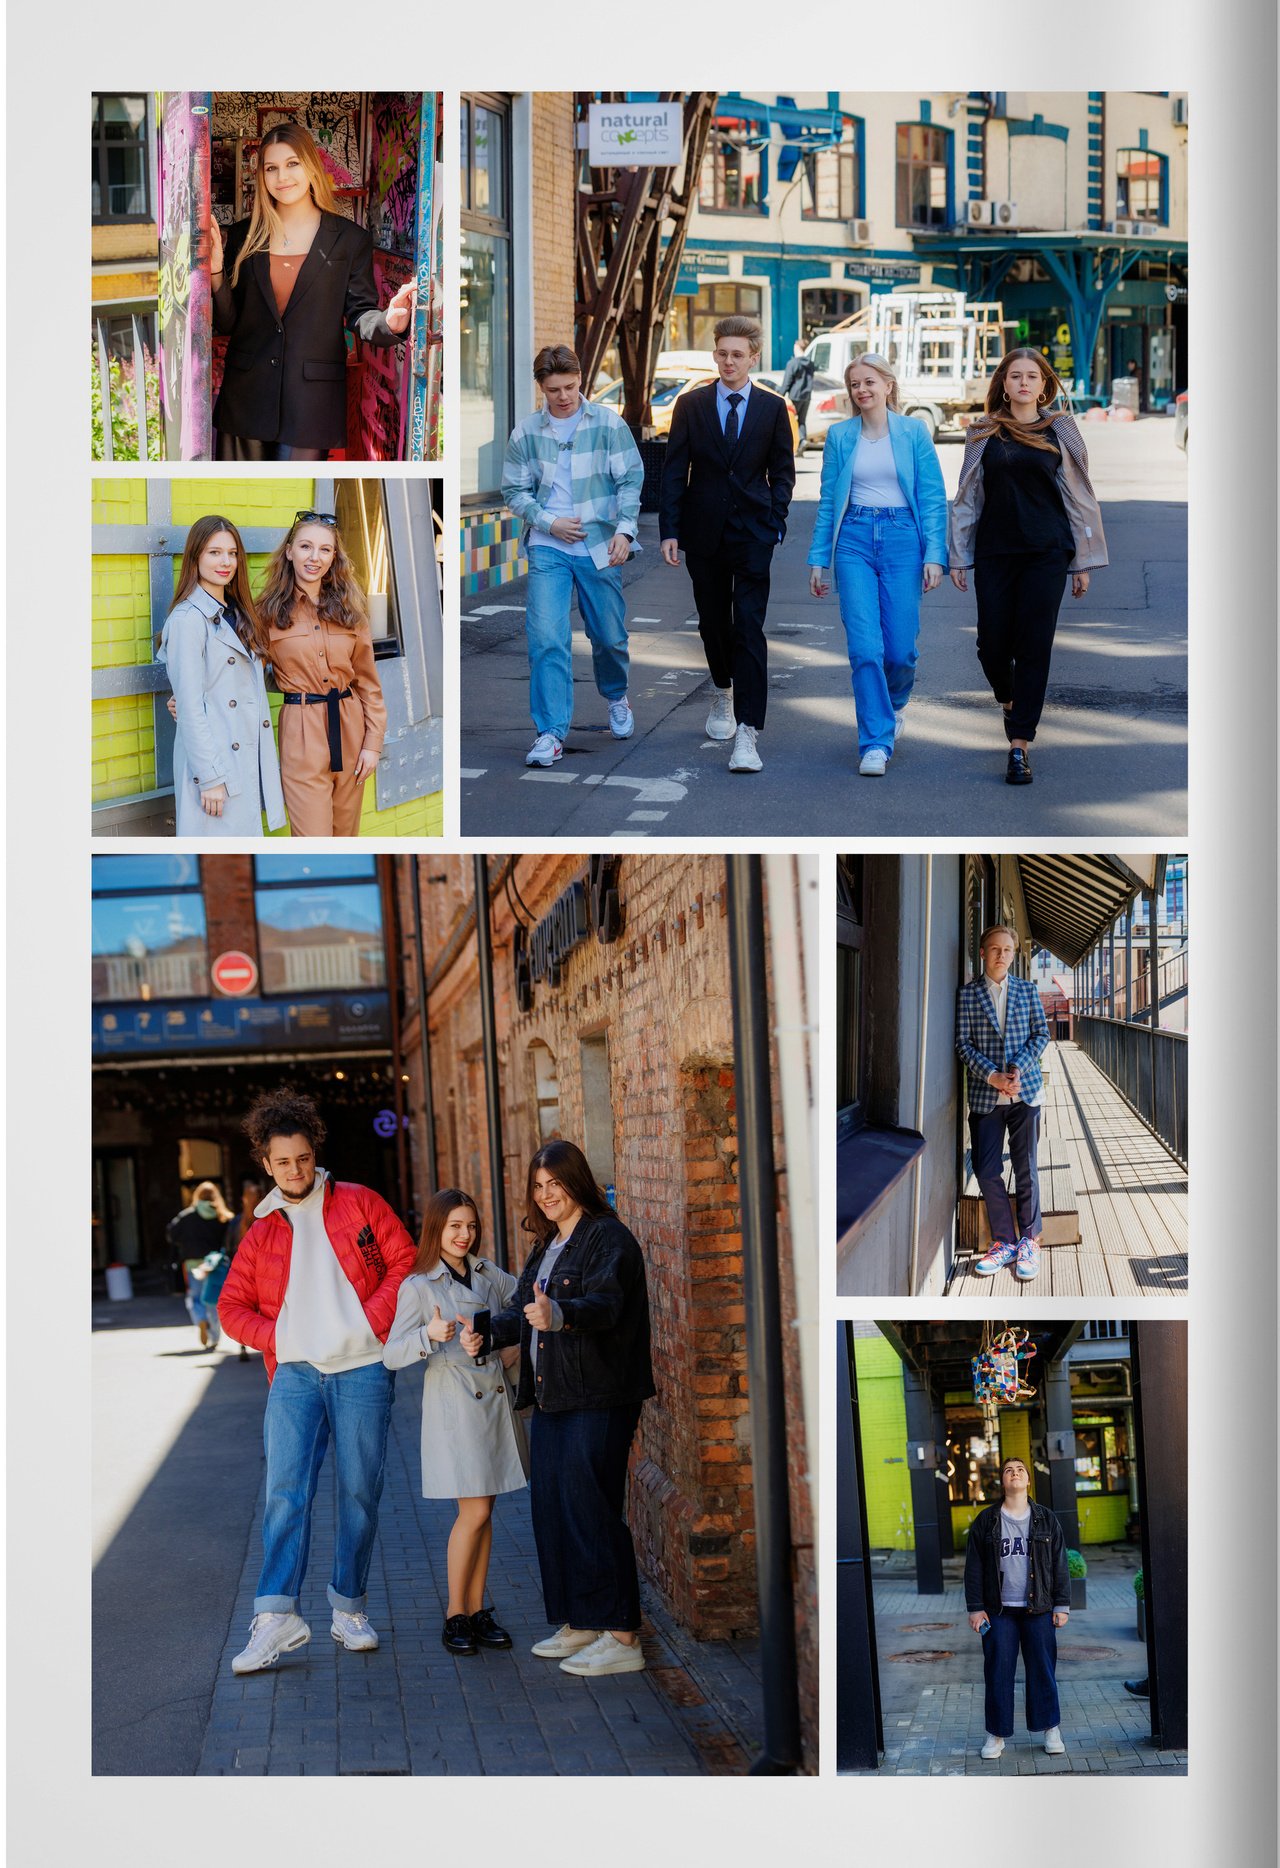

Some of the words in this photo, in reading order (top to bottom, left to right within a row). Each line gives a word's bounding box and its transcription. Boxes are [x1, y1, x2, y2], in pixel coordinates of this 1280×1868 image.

[601, 111, 668, 127] natural
[137, 1012, 151, 1028] 7
[201, 1009, 213, 1022] 4
[360, 1246, 374, 1269] THE
[368, 1243, 384, 1281] NORTH
